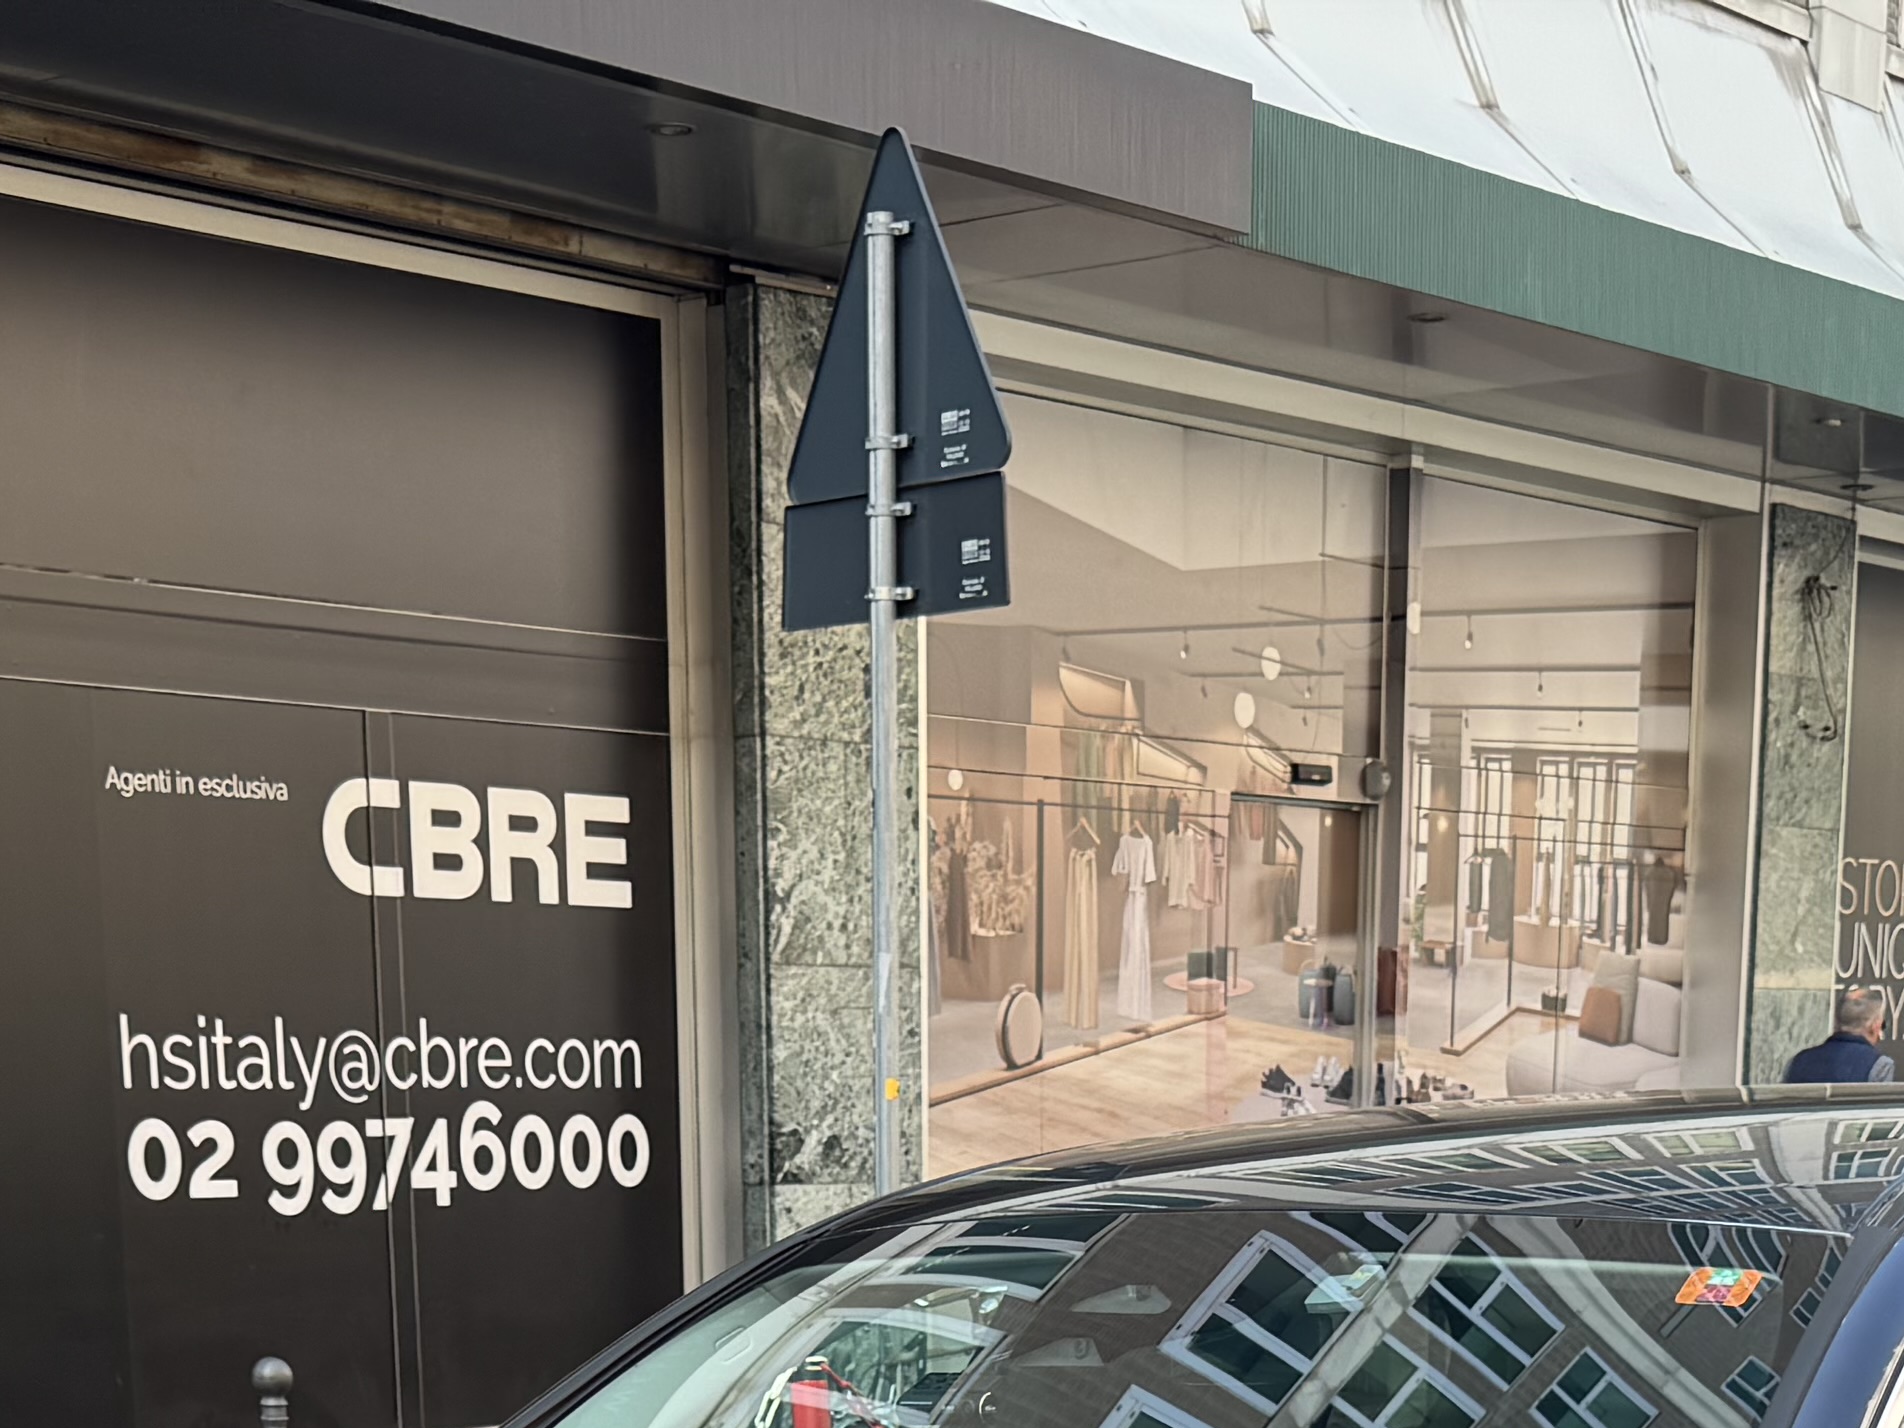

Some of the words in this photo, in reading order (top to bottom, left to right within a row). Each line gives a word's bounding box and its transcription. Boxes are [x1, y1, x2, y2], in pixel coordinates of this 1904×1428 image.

[105, 765, 173, 799] Agenti
[175, 769, 195, 796] in
[198, 772, 289, 802] esclusiva
[321, 777, 633, 909] CBRE
[118, 1012, 643, 1111] hsitaly@cbre.com
[127, 1117, 239, 1202] 02
[261, 1100, 651, 1217] 99746000
